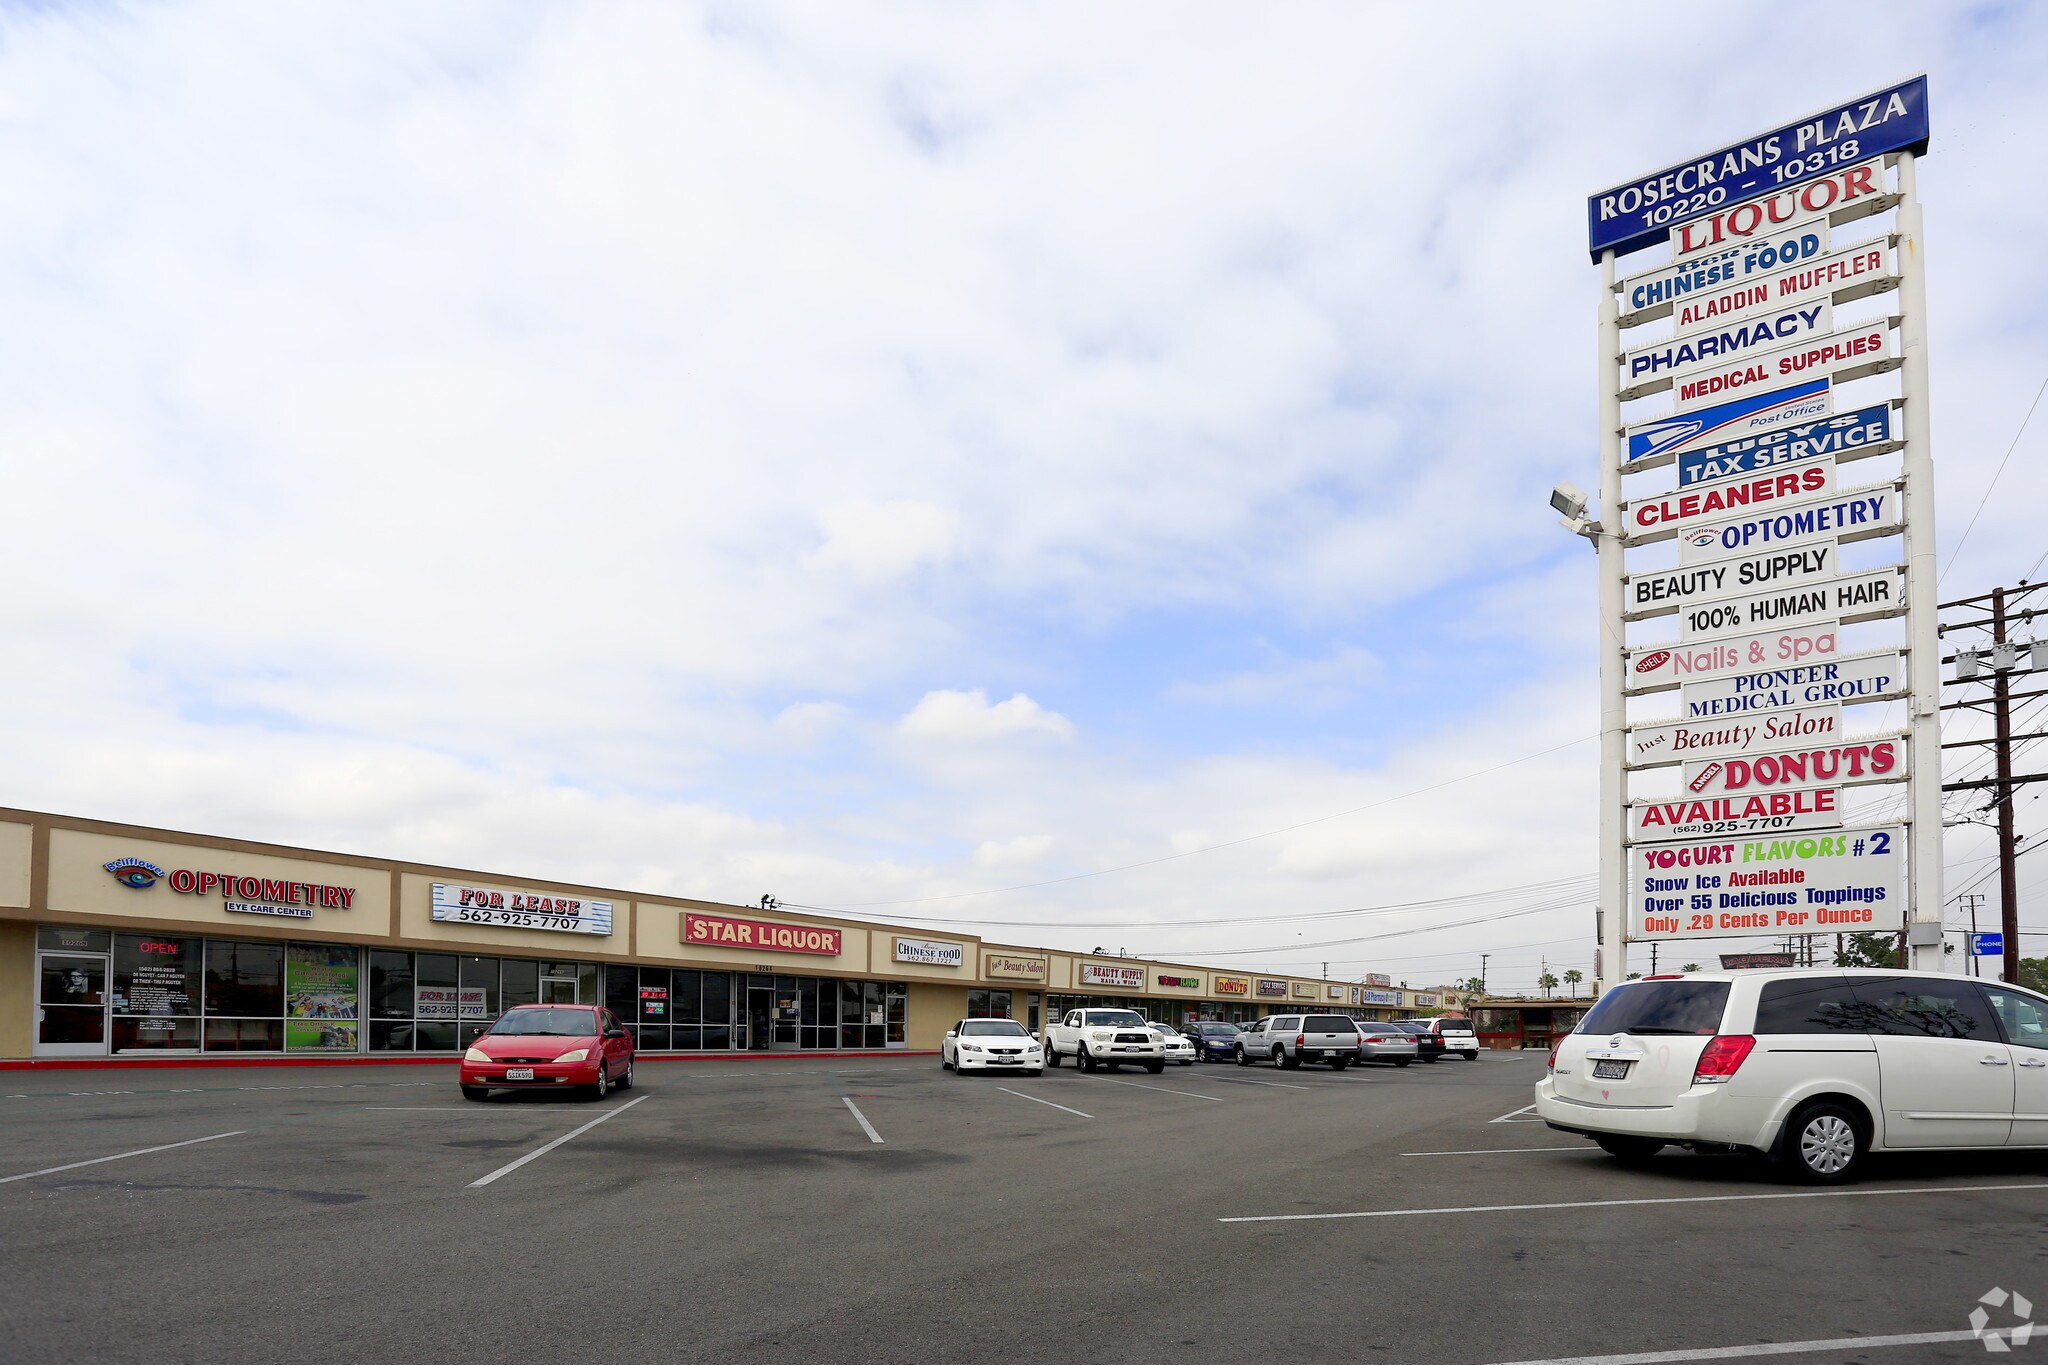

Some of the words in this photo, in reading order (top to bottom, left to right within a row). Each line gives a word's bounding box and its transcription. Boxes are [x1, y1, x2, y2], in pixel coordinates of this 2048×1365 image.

[1600, 136, 1782, 221] ROSECRANS
[1796, 92, 1908, 152] PLAZA
[1642, 187, 1727, 228] 10220
[1771, 140, 1860, 183] 10318
[1679, 166, 1877, 256] LIQUOR
[1632, 262, 1735, 309] CHINESE
[1744, 233, 1820, 274] FOOD
[1680, 284, 1768, 326] ALADDIN
[1779, 250, 1881, 296] MUFFLER
[1632, 305, 1823, 378] PHARMACY
[1681, 365, 1768, 401] MEDICAL
[1779, 333, 1882, 375] SUPPLIES
[1750, 413, 1780, 427] Post
[1783, 404, 1825, 419] Office
[1686, 454, 1748, 483] TAX
[1753, 422, 1882, 468] SERVICE
[1704, 414, 1859, 458] LUCY'S
[1636, 467, 1826, 527] CLEANERS
[1722, 496, 1885, 549] OPTOMETRY
[1637, 567, 1726, 603] BEAUTY
[1739, 548, 1828, 585] SUPPLY
[1688, 605, 1740, 631] 100%
[1750, 590, 1826, 622] HUMAN
[1837, 580, 1889, 608] HAIR
[1637, 652, 1669, 672] SHEILA
[1673, 645, 1738, 675] Nails
[1749, 640, 1766, 663] &
[1778, 633, 1836, 661] Spa
[1689, 690, 1795, 718] MEDICAL
[1804, 675, 1890, 702] GROUP
[1735, 663, 1839, 693] PIONEER
[1637, 734, 1667, 753] Just
[1672, 723, 1756, 751] Beauty
[1764, 713, 1834, 740] Salon
[1693, 765, 1720, 790] ANGEL
[1724, 742, 1895, 790] DONUTS
[1641, 789, 1835, 827] AVAILABLE
[1645, 844, 1735, 870] YOGURT
[1743, 835, 1847, 863] FLAVORS
[105, 857, 166, 877] Bellflower
[169, 869, 357, 909] OPTOMETRY
[1645, 876, 1689, 892] Snow
[1696, 874, 1721, 889] Ice
[1728, 868, 1805, 888] Available
[1645, 897, 1684, 912] Over
[1691, 894, 1712, 910] 55
[1720, 891, 1797, 909] Delicious
[1805, 886, 1886, 906] Toppings
[228, 902, 248, 911] EYE
[251, 905, 275, 913] CARE
[277, 907, 312, 917] CENTER
[459, 888, 505, 910] FOR
[511, 894, 582, 917] LEASE
[459, 908, 581, 931] 562-925-7707
[1645, 916, 1679, 933] Only
[1686, 914, 1714, 930] .29
[1720, 911, 1769, 929] Cents
[1776, 910, 1809, 927] Per
[1817, 908, 1873, 924] Ounce
[140, 942, 177, 954] OPEN
[692, 919, 753, 944] STAR
[758, 927, 835, 951] LIQUOR
[898, 942, 936, 957] CHINESE
[939, 949, 960, 959] FOOD
[1004, 960, 1026, 975] Beauty
[1026, 961, 1043, 973] Salon
[1093, 967, 1119, 978] BEAUTY
[1121, 969, 1143, 980] SUPPLY
[1725, 955, 1790, 967] TAQUERIA
[418, 991, 444, 1001] FOR
[1219, 982, 1248, 992] DONUTS
